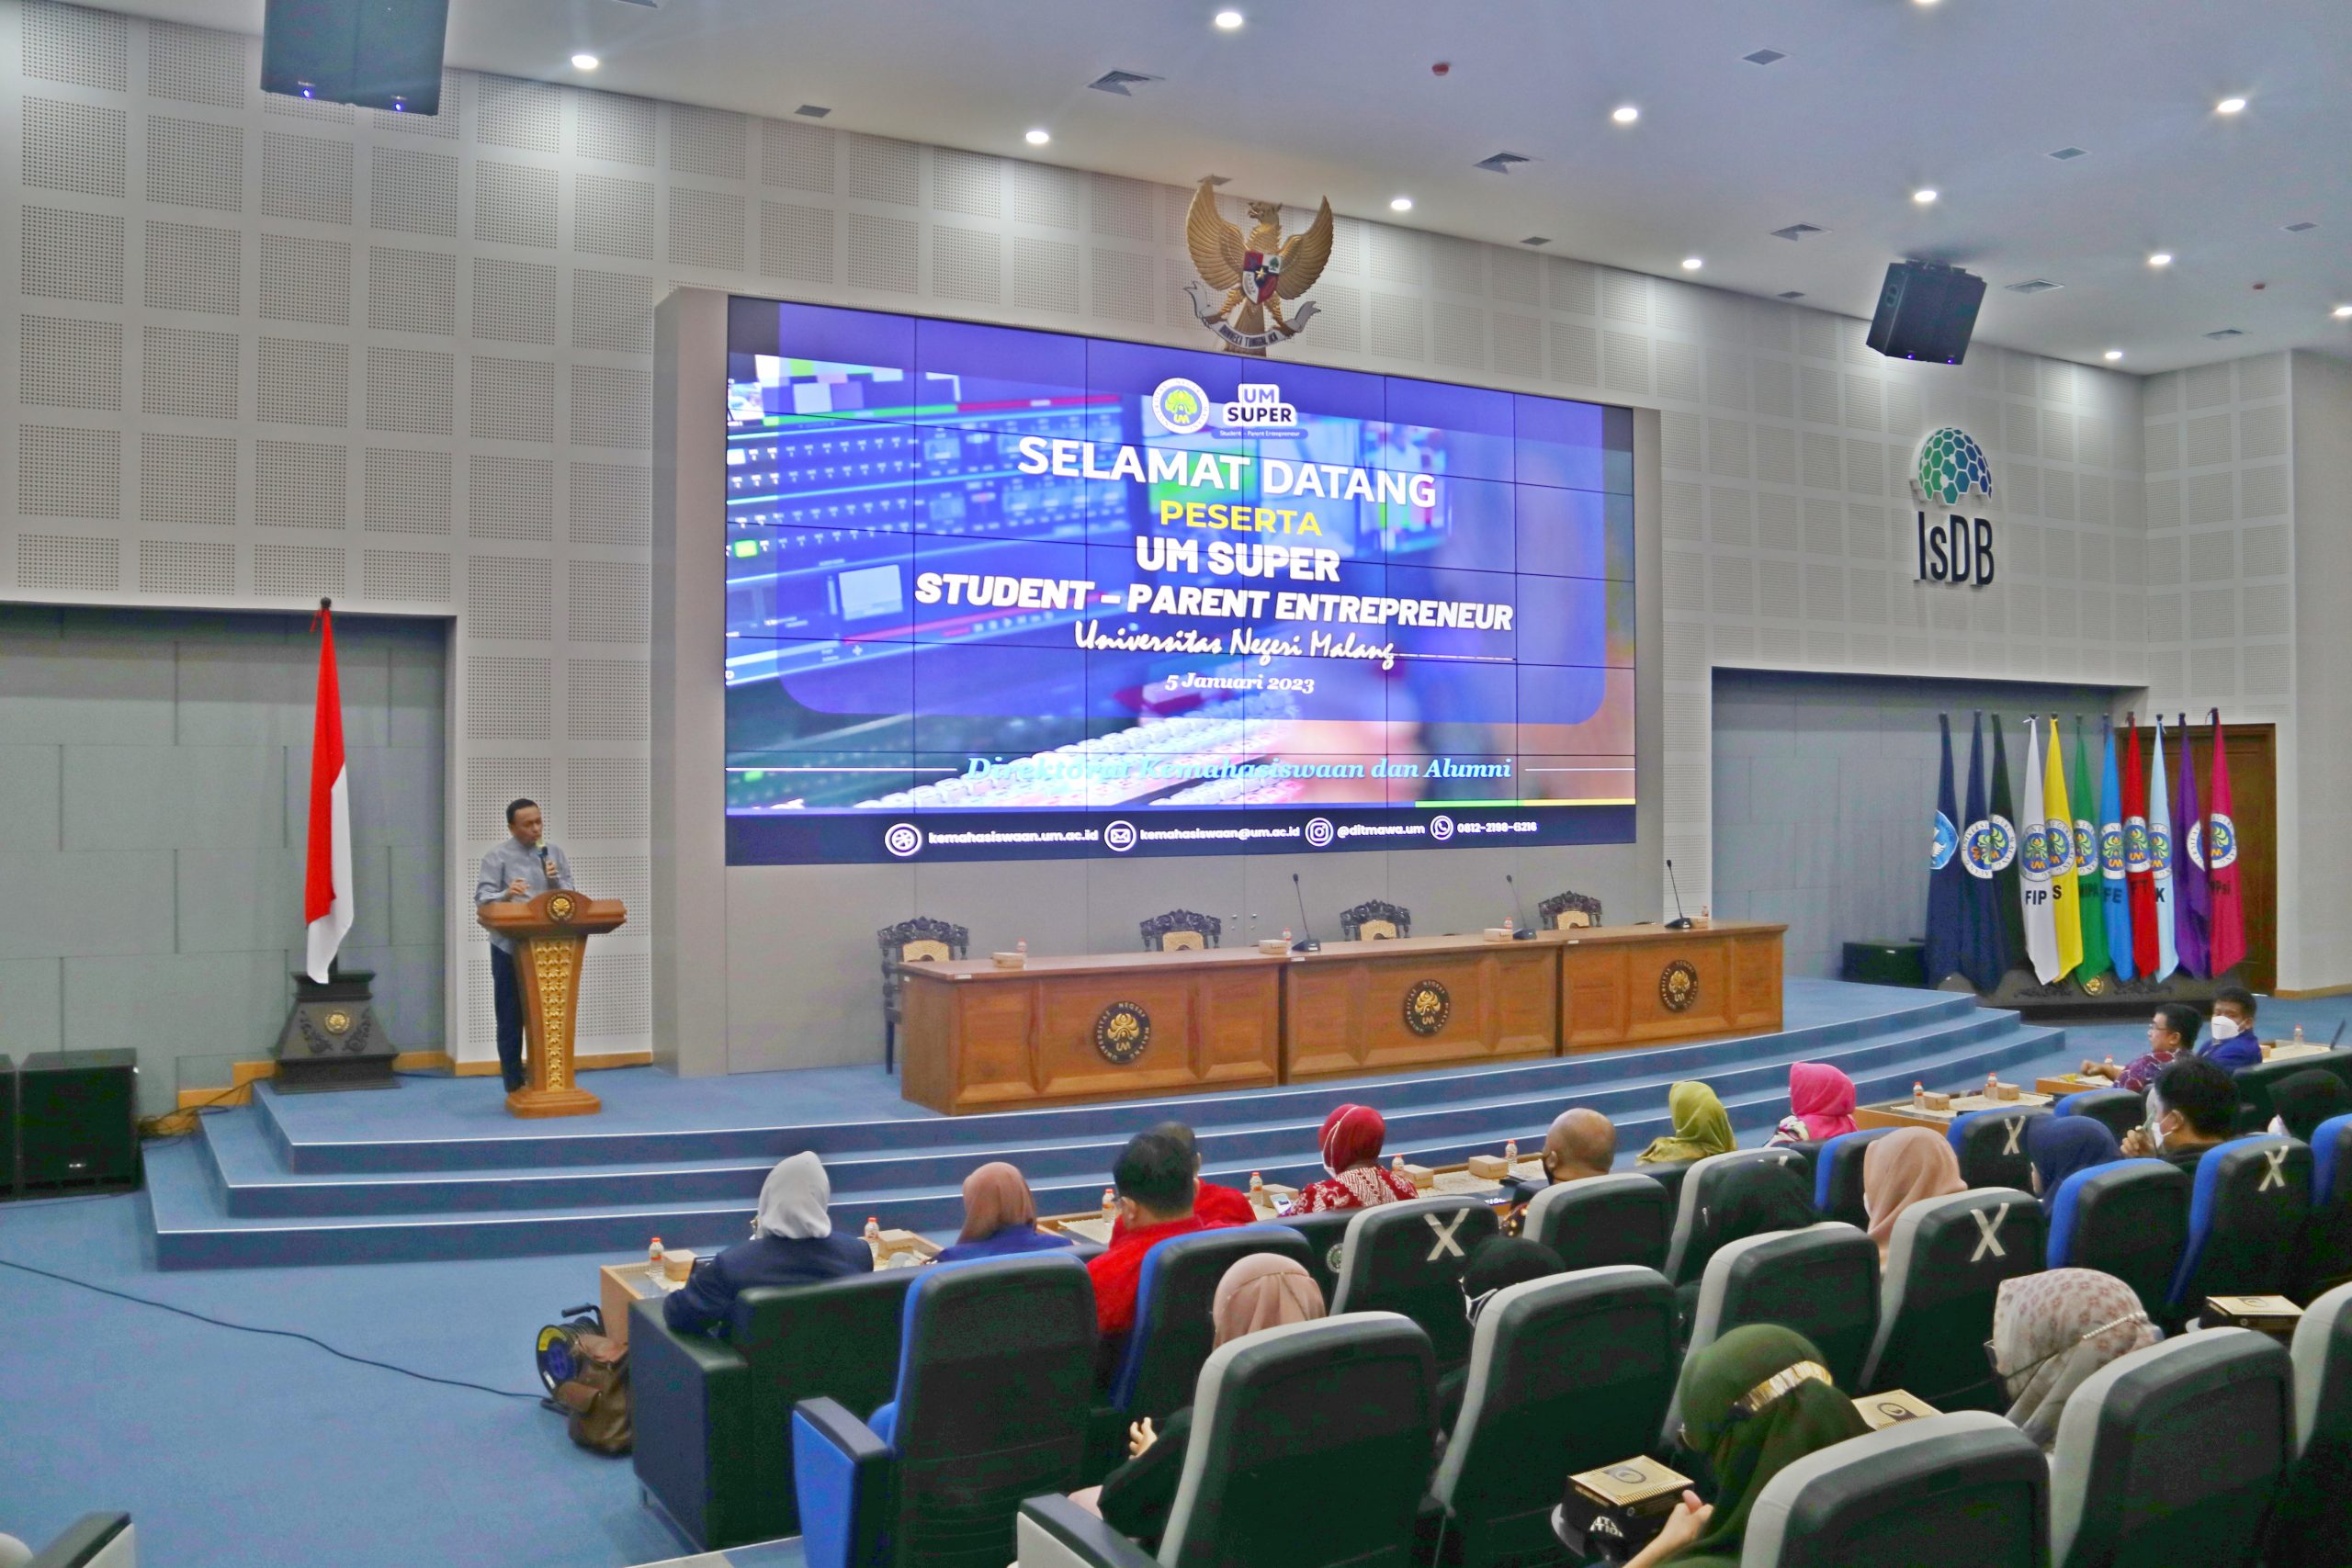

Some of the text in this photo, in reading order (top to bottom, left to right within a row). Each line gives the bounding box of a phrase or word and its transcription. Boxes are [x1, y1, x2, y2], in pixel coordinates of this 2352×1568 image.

[1244, 389, 1275, 403] UM
[1227, 407, 1292, 423] SUPER
[1017, 436, 1256, 491] SELAMAT
[1262, 457, 1437, 508] DATANG
[1159, 499, 1323, 536] PESERTA
[1917, 511, 1995, 585] IsDB
[1136, 536, 1340, 582] UM SUPER
[915, 571, 1095, 611] STUDENT
[1127, 583, 1270, 620] PARENT
[1274, 593, 1514, 632] ENTREPRENEUR
[1074, 620, 1396, 670] Universitas Negeri Malang
[1165, 672, 1315, 694] 5 Januari 2023
[966, 756, 1512, 781] Direktorat Kemahasiswaan dan Alumni
[928, 829, 1099, 844] kemahasiswaan.um.ac.id
[1139, 826, 1300, 840] kemahasiswaan@um.ac.id
[1337, 823, 1425, 839] @ditmawa.um
[2025, 890, 2047, 905] FIP
[2052, 885, 2063, 900] S
[2103, 887, 2123, 904] FE
